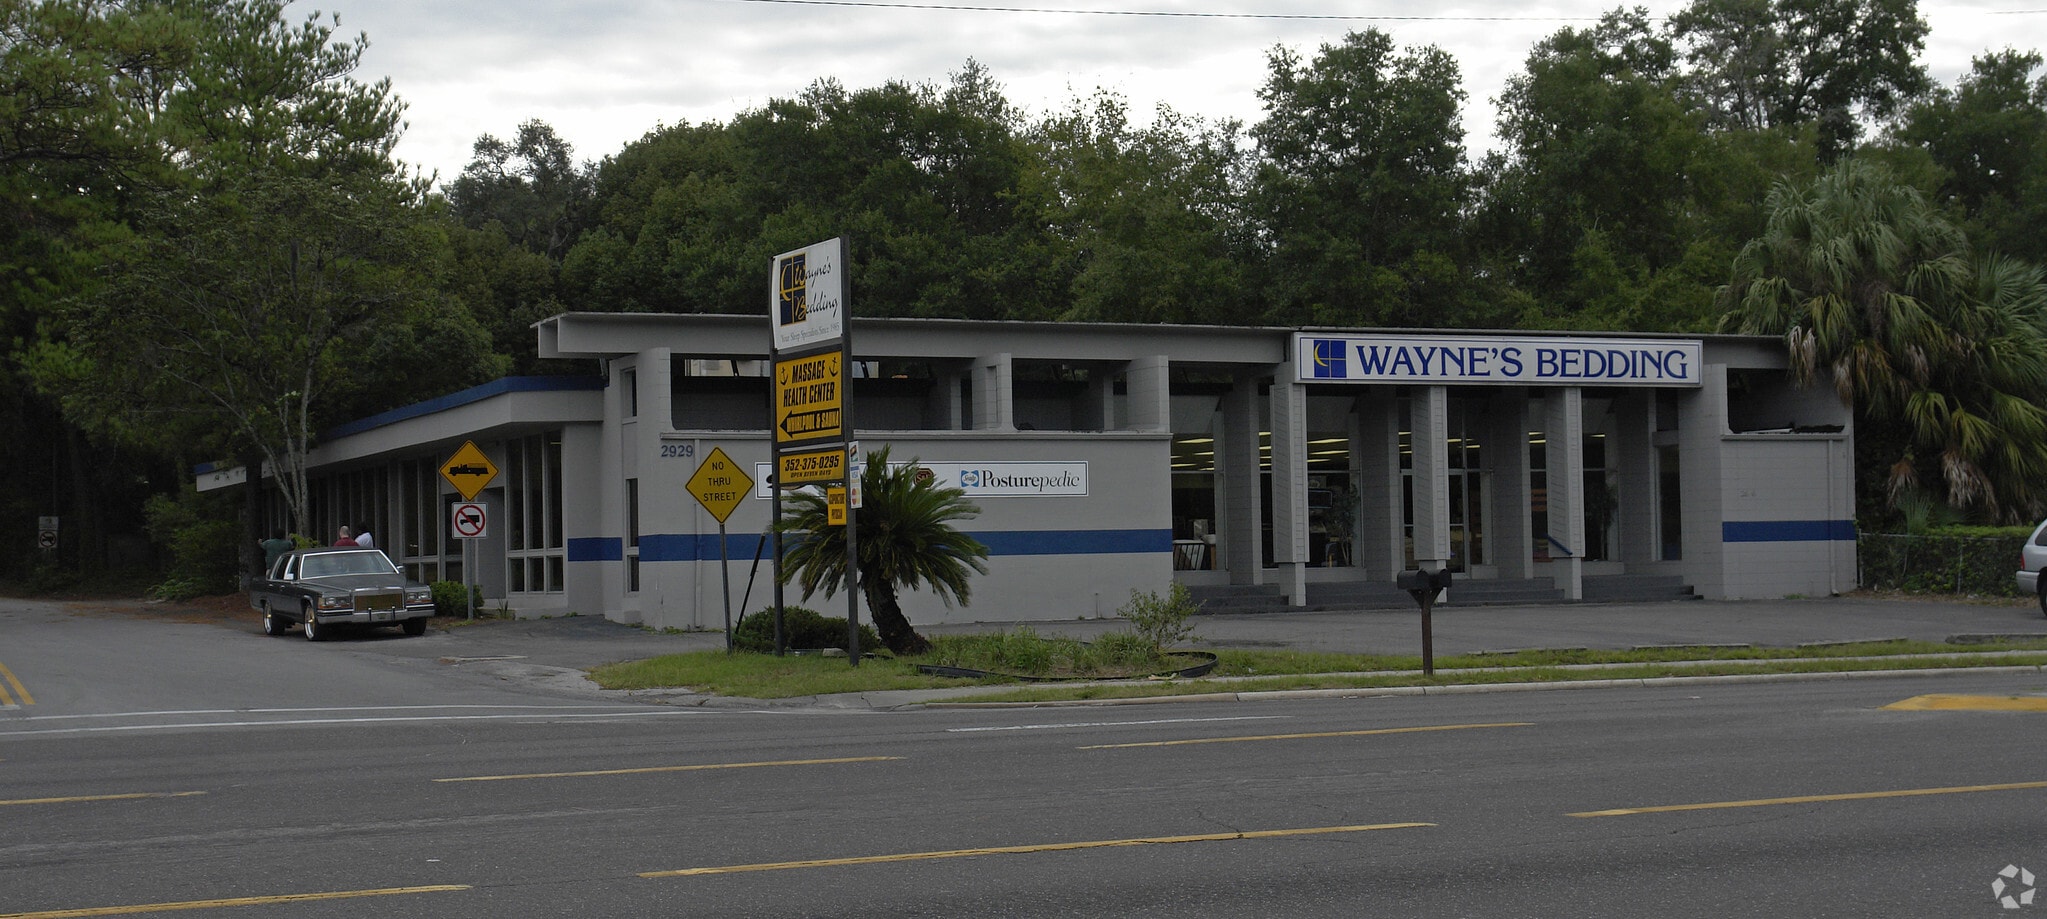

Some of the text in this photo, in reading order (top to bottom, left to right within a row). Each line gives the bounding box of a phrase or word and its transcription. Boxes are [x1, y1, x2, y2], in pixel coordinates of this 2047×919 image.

[794, 256, 831, 287] Wayne's
[794, 291, 838, 320] Bedding
[792, 360, 825, 383] MASSAGE
[1356, 345, 1688, 379] WAYNE'S BEDDING
[783, 382, 835, 407] HEALTH CENTER
[661, 445, 694, 457] 2929
[712, 462, 724, 470] NO
[708, 477, 731, 487] THRU
[982, 470, 1080, 492] Posturepedic
[703, 492, 736, 502] STREET
